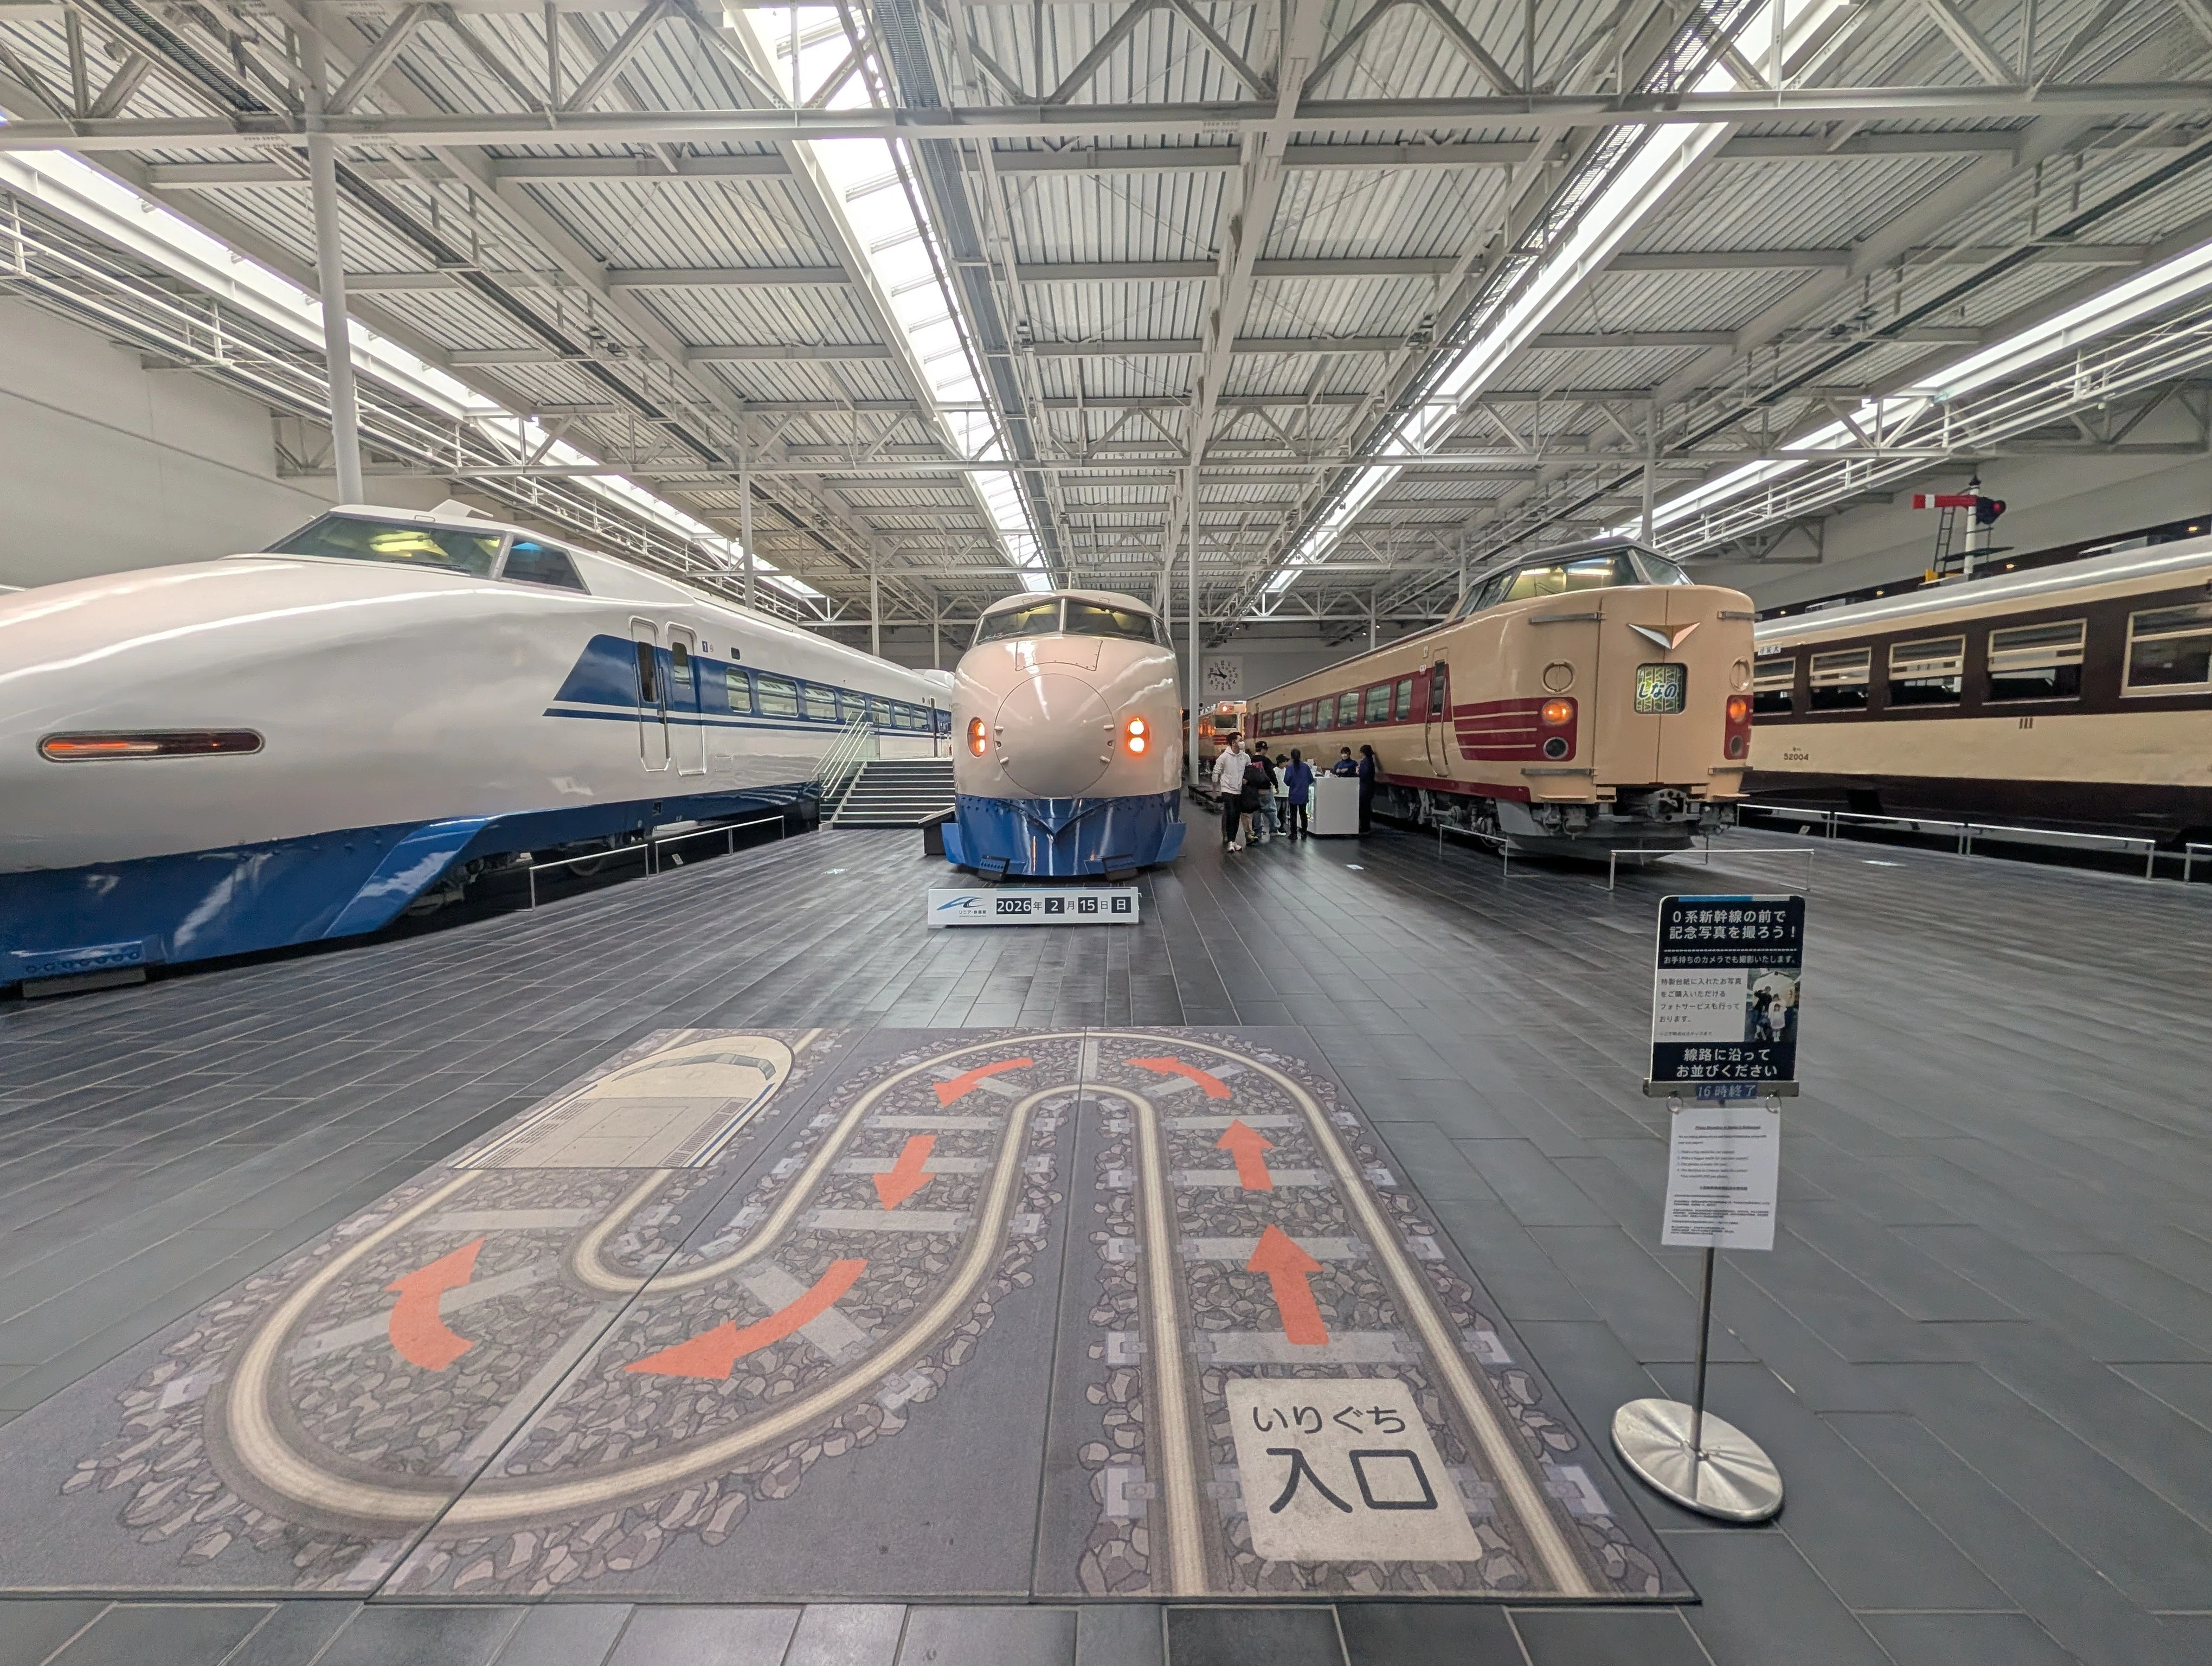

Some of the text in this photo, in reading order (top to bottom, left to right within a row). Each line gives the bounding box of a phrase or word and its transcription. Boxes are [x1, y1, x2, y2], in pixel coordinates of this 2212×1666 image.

[1638, 683, 1677, 699] しなの
[1673, 909, 1786, 923] 0系新幹線の前で
[1669, 926, 1796, 939] 記念写真を撮ろう！
[1663, 955, 1796, 964] お手持ちのカメラでも撮影いたします。
[1661, 990, 1726, 998] をご購入いただける
[1684, 1048, 1771, 1062] 線路に沿って
[1676, 1064, 1778, 1078] お並びください
[1697, 1085, 1756, 1098] 16時終了
[1252, 1406, 1406, 1434] いりぐち
[1266, 1447, 1438, 1514] 入口
